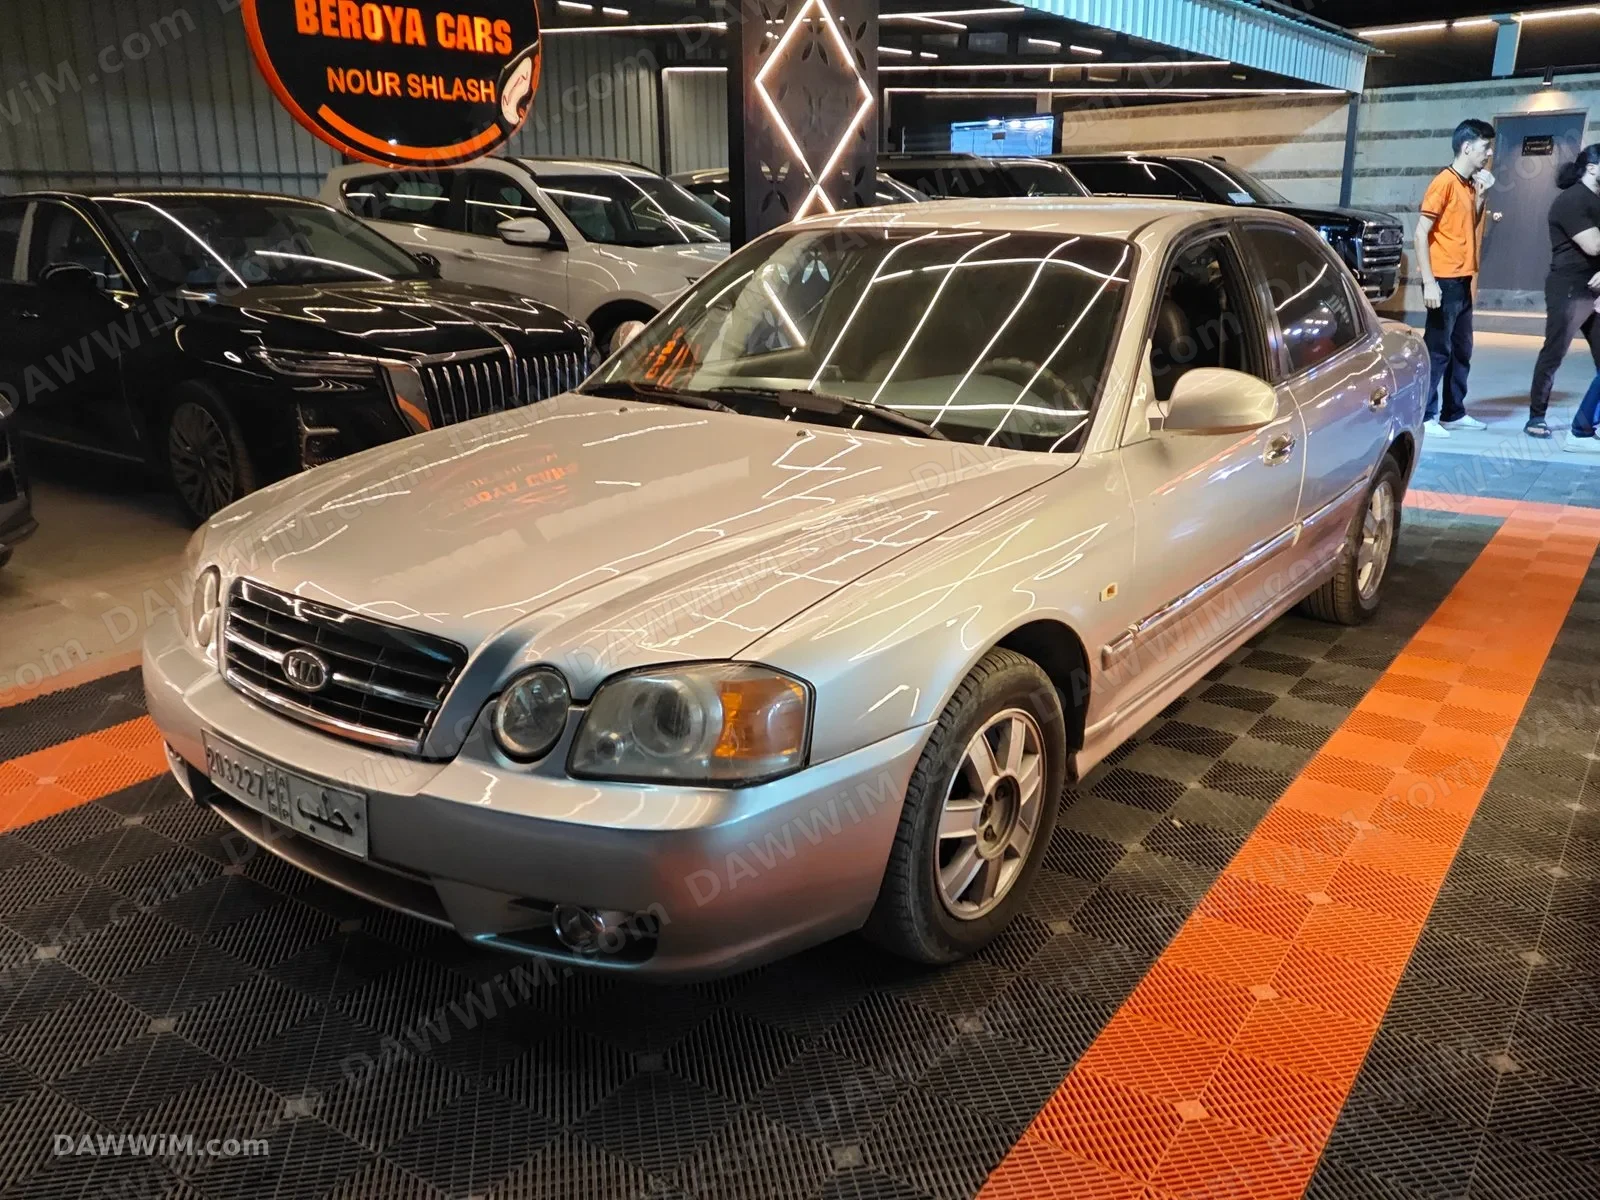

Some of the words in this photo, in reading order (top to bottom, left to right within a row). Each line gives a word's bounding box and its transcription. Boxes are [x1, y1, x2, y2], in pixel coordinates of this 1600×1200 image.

[294, 0, 427, 46] BEROYA
[435, 12, 512, 55] CARS
[326, 66, 401, 97] NOUR
[407, 73, 496, 103] SHLASH
[288, 656, 319, 685] KIA
[297, 787, 353, 836] حلب
